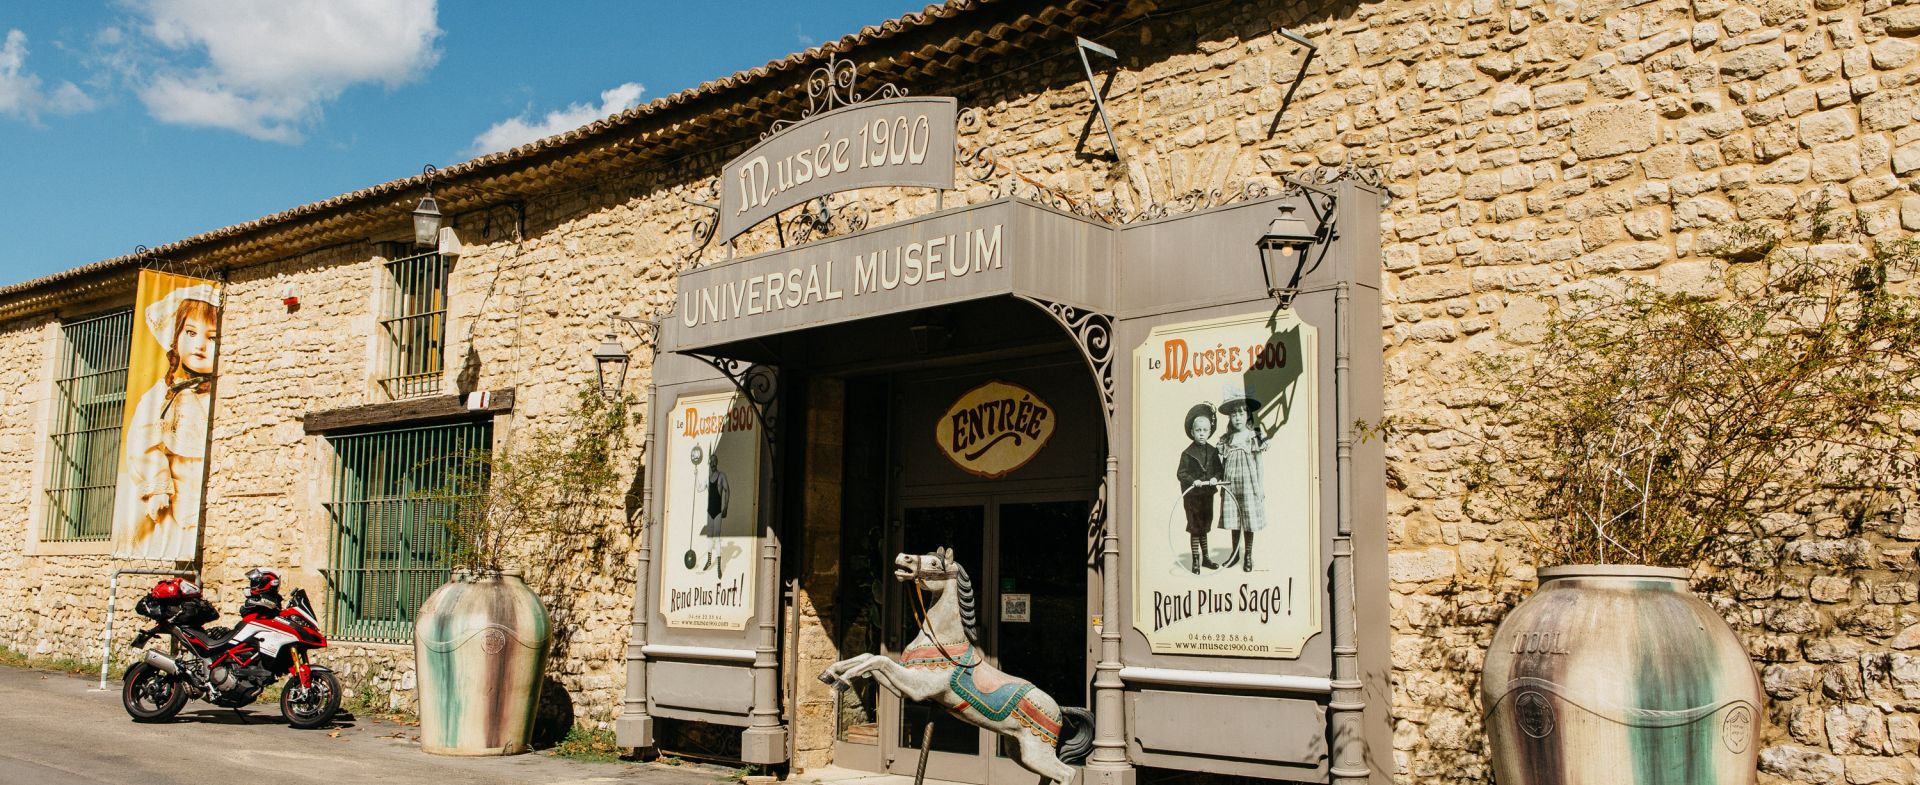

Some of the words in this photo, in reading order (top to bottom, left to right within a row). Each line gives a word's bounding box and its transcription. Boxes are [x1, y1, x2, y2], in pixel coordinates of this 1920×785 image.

[736, 131, 851, 217] Musée
[858, 115, 931, 169] 1900
[683, 261, 843, 328] UNIVERSAL
[853, 224, 1004, 296] MUSEUM
[1148, 357, 1161, 370] Le
[1247, 341, 1287, 371] 1900
[727, 405, 754, 433] 1900
[952, 394, 1047, 453] ENTRÉE
[670, 588, 692, 613] Rend
[693, 586, 713, 607] Plus
[1153, 590, 1192, 632] Rend
[1198, 589, 1233, 615] Plus
[1238, 583, 1281, 625] Sage
[1175, 641, 1269, 652] www.musee1900.com
